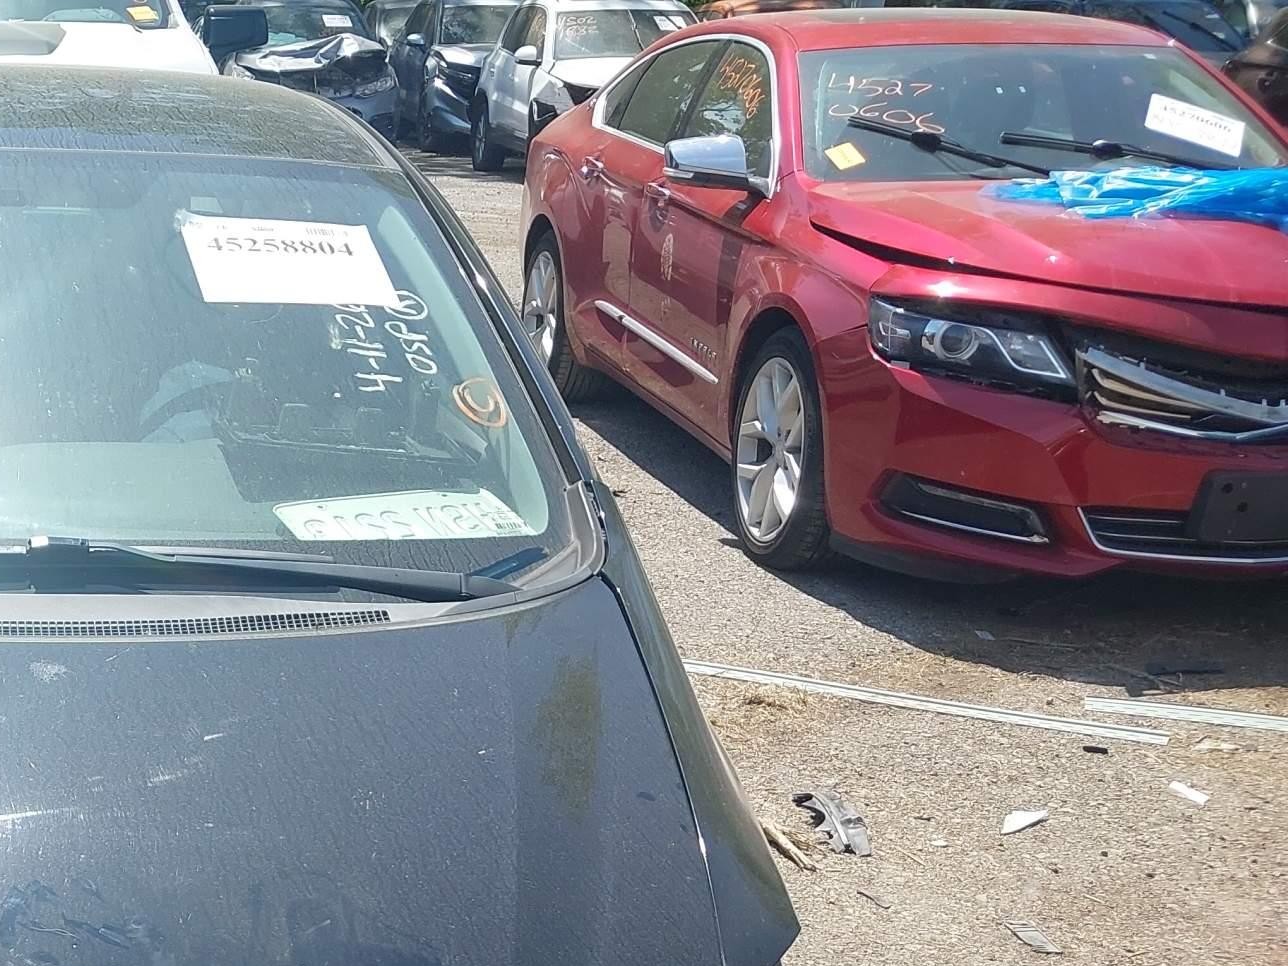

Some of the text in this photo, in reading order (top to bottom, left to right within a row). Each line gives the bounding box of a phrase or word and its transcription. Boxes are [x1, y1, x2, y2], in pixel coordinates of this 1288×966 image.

[828, 73, 933, 97] 4527
[829, 102, 945, 134] 0606
[207, 236, 354, 257] 45258804
